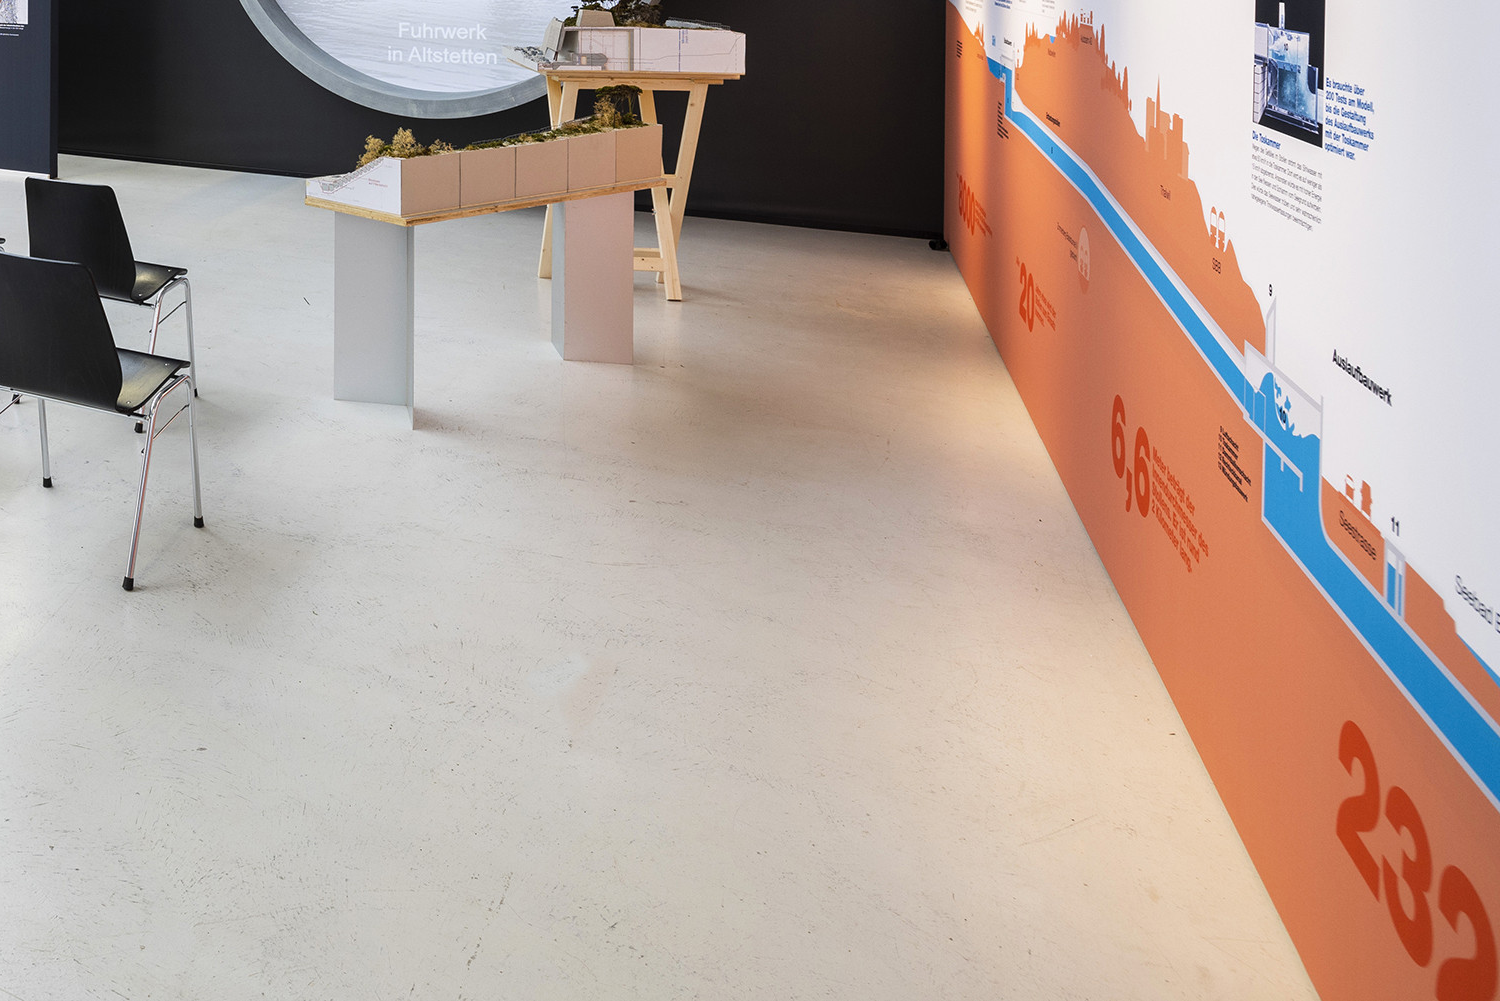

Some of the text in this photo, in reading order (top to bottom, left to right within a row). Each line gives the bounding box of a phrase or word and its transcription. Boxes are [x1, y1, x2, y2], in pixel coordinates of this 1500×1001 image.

[388, 46, 497, 64] in Altstetten
[398, 22, 487, 40] Fuhrwerk
[1019, 262, 1034, 332] 20
[1332, 348, 1392, 407] Auslaufbauwerk
[1112, 394, 1150, 518] 6,6
[1390, 516, 1400, 537] 11
[1455, 574, 1493, 626] Seebad
